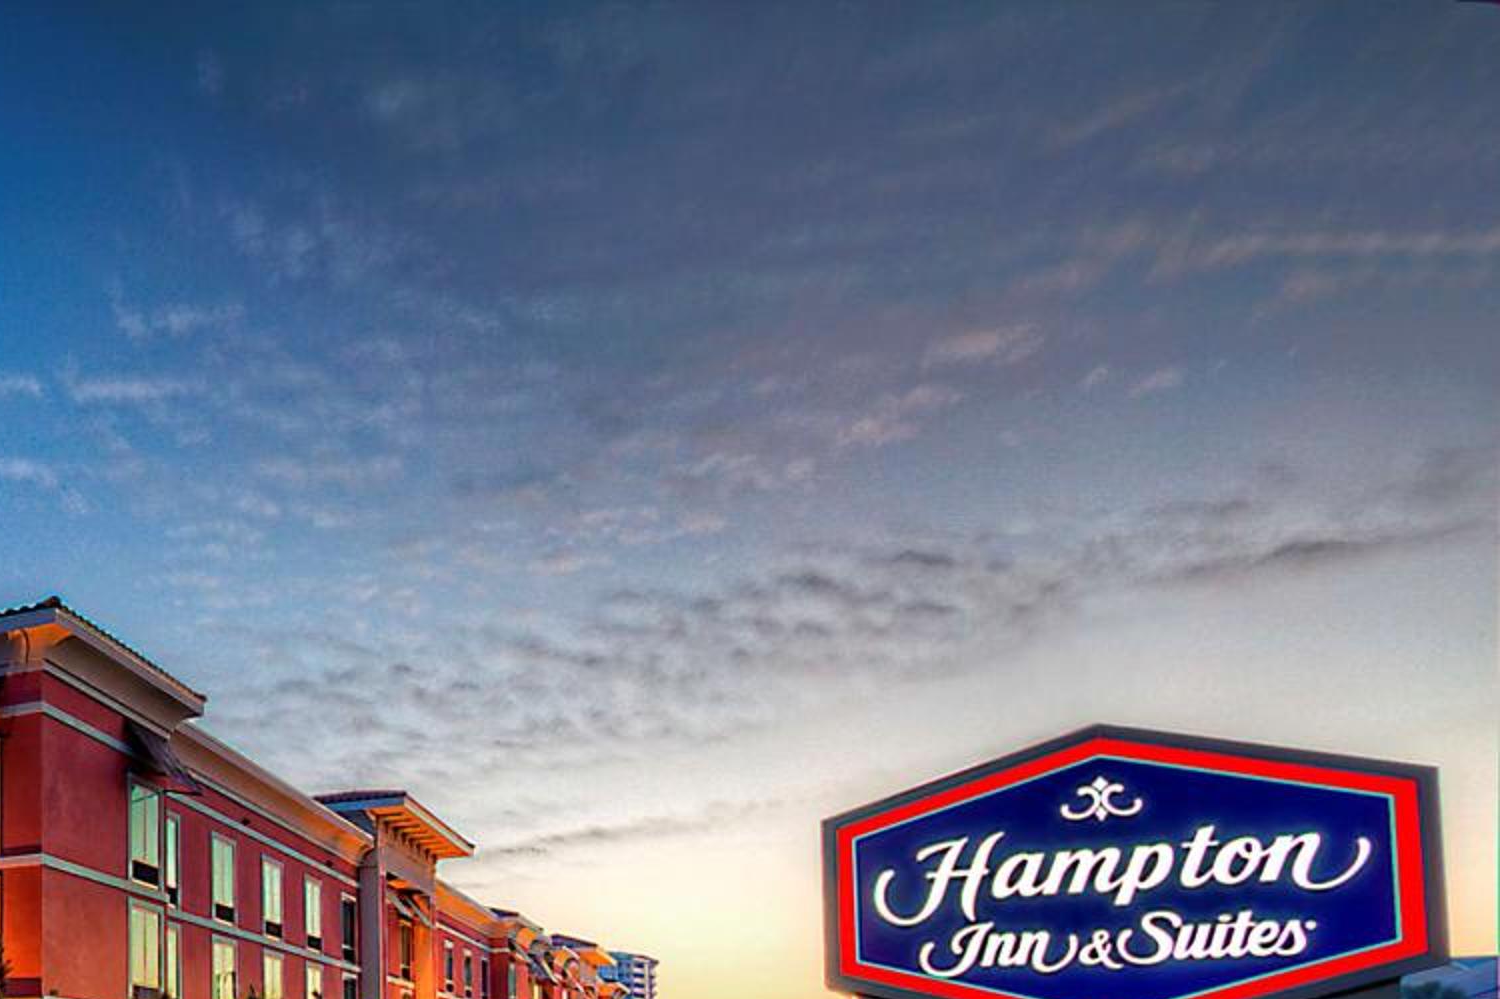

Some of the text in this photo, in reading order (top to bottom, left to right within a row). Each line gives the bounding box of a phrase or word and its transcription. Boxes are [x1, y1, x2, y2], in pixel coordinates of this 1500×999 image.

[874, 826, 1371, 926] Hampton
[920, 920, 1079, 977] Inn
[1115, 911, 1308, 971] Suites
